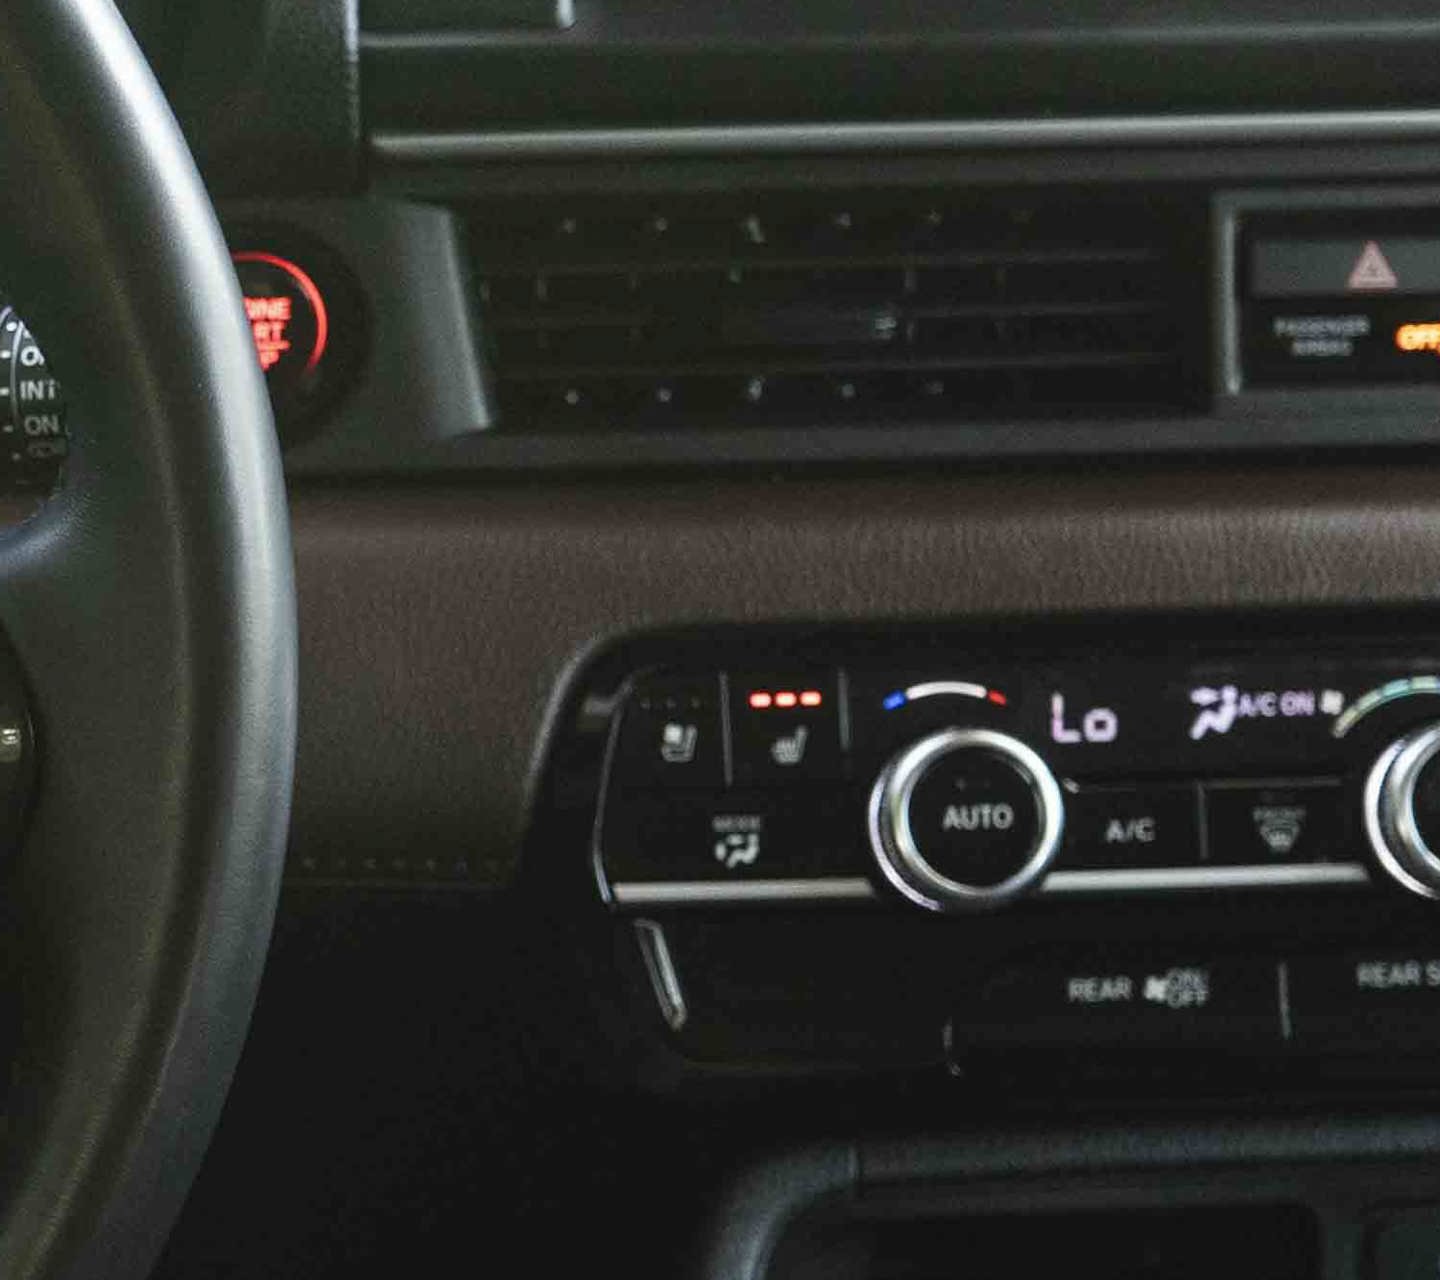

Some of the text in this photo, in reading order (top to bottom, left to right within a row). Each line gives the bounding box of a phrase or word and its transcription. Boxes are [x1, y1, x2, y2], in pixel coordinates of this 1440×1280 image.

[1238, 690, 1317, 717] A/C ON
[942, 803, 1015, 831] AUTO
[1105, 816, 1156, 844] A/C
[1356, 960, 1422, 988] REAR
[1067, 976, 1132, 1003] REAR
